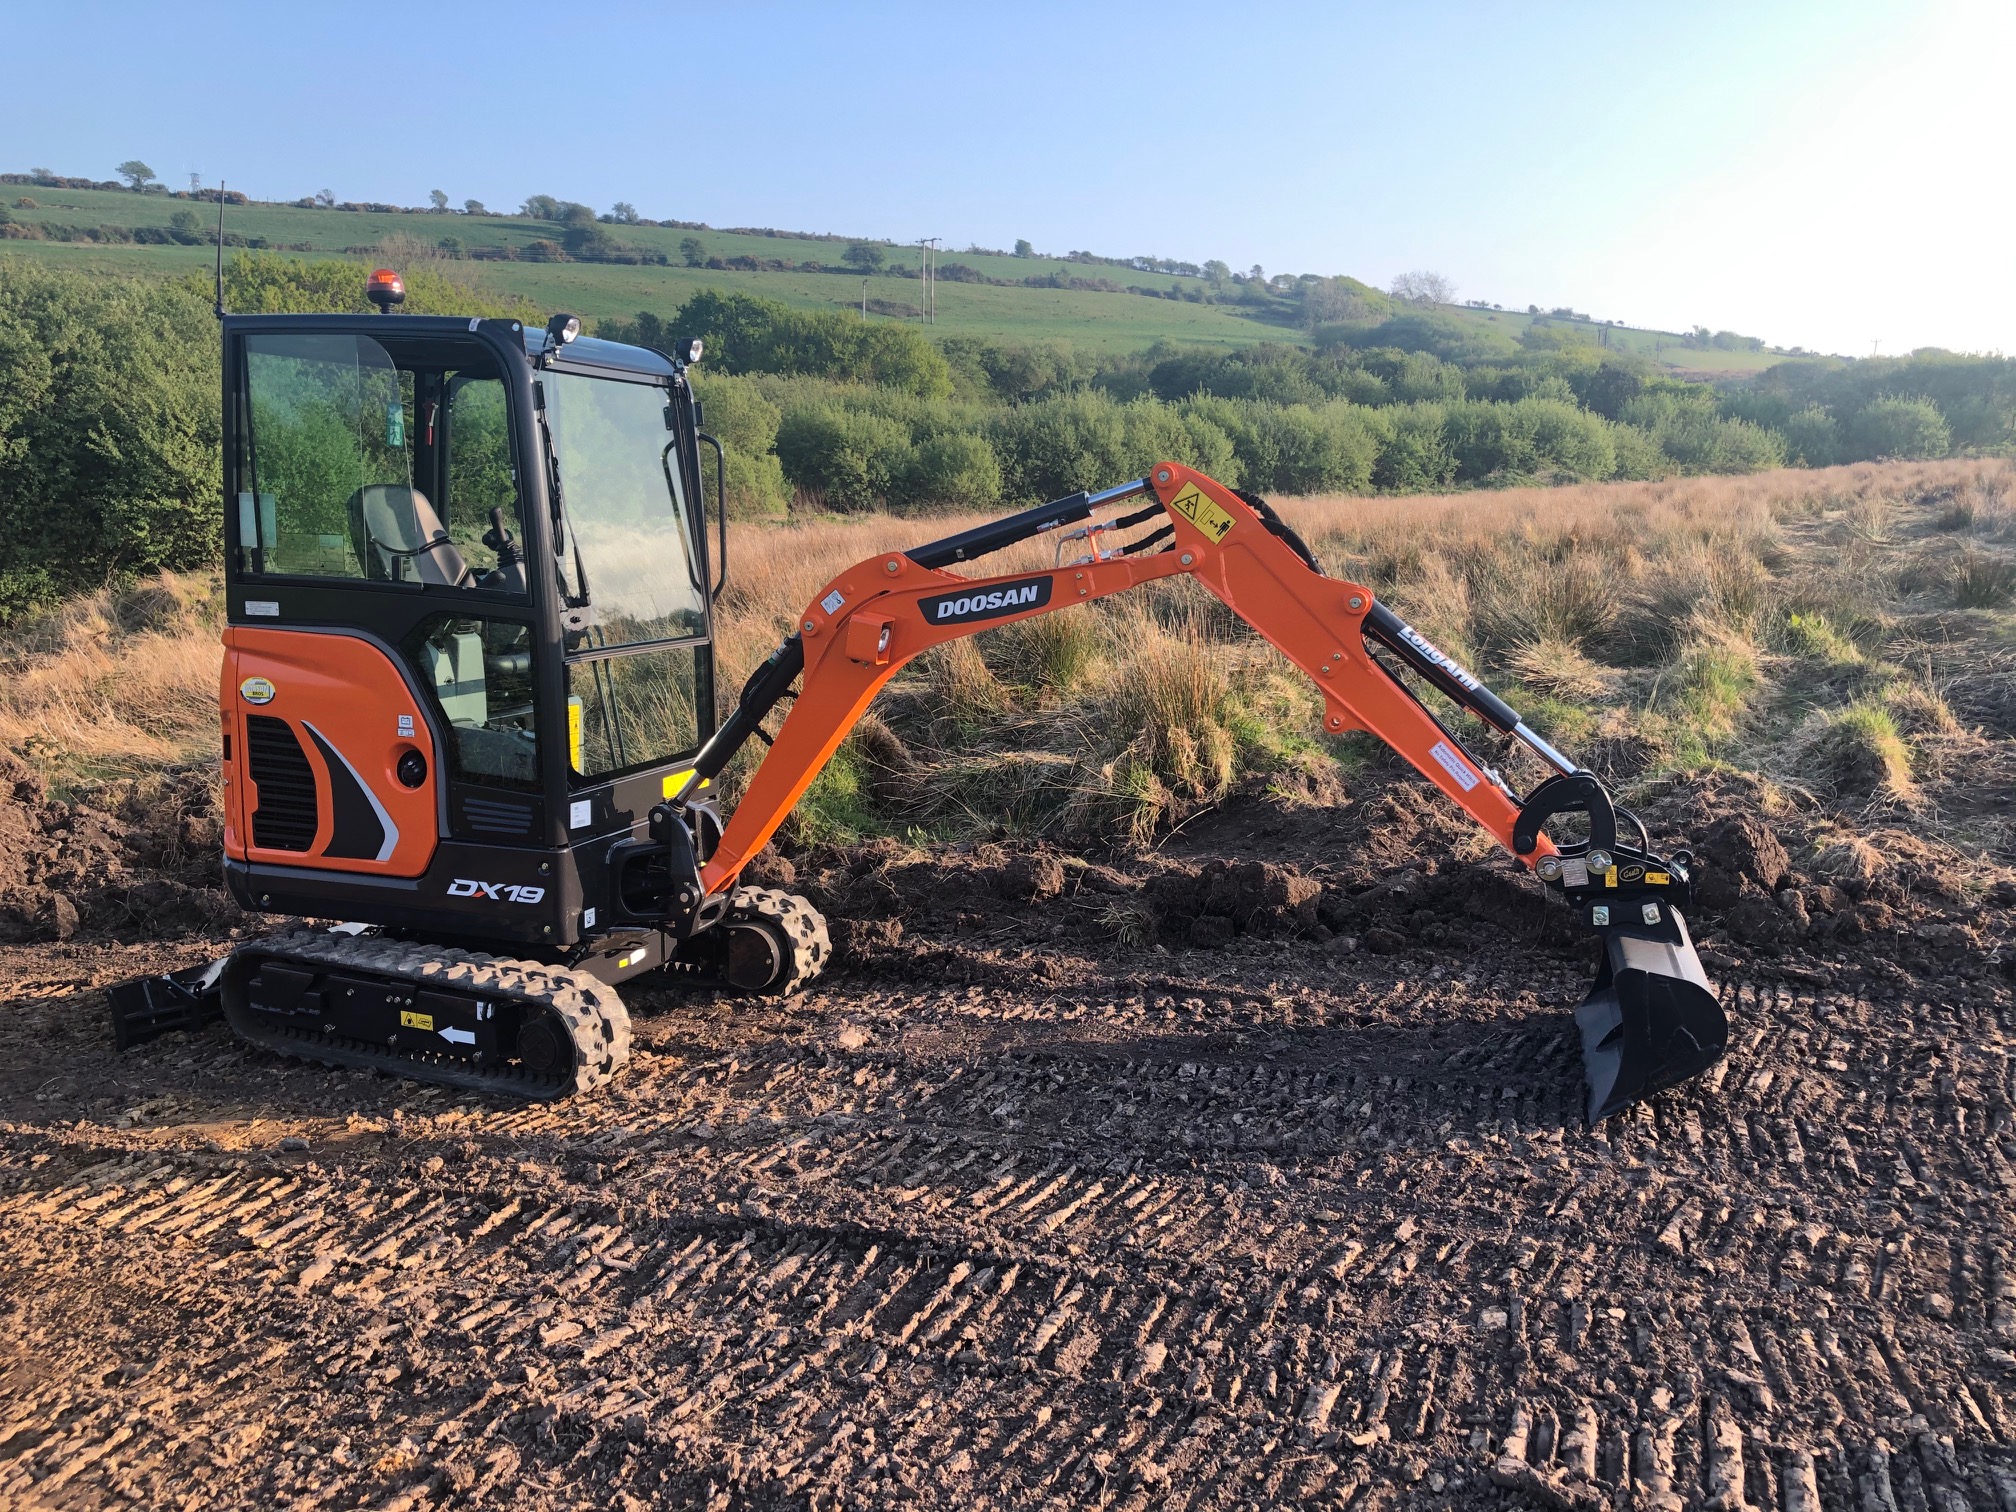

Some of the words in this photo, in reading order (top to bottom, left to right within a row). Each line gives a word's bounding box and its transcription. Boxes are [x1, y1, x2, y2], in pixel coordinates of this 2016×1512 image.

[937, 585, 1038, 618] DOOSAN
[1397, 626, 1479, 691] LongArm
[1437, 744, 1456, 764] Automatic
[1455, 762, 1466, 774] Quick
[1465, 772, 1476, 785] Hitch
[1439, 755, 1450, 767] Safety
[1454, 771, 1470, 787] Required
[446, 878, 545, 904] DX19
